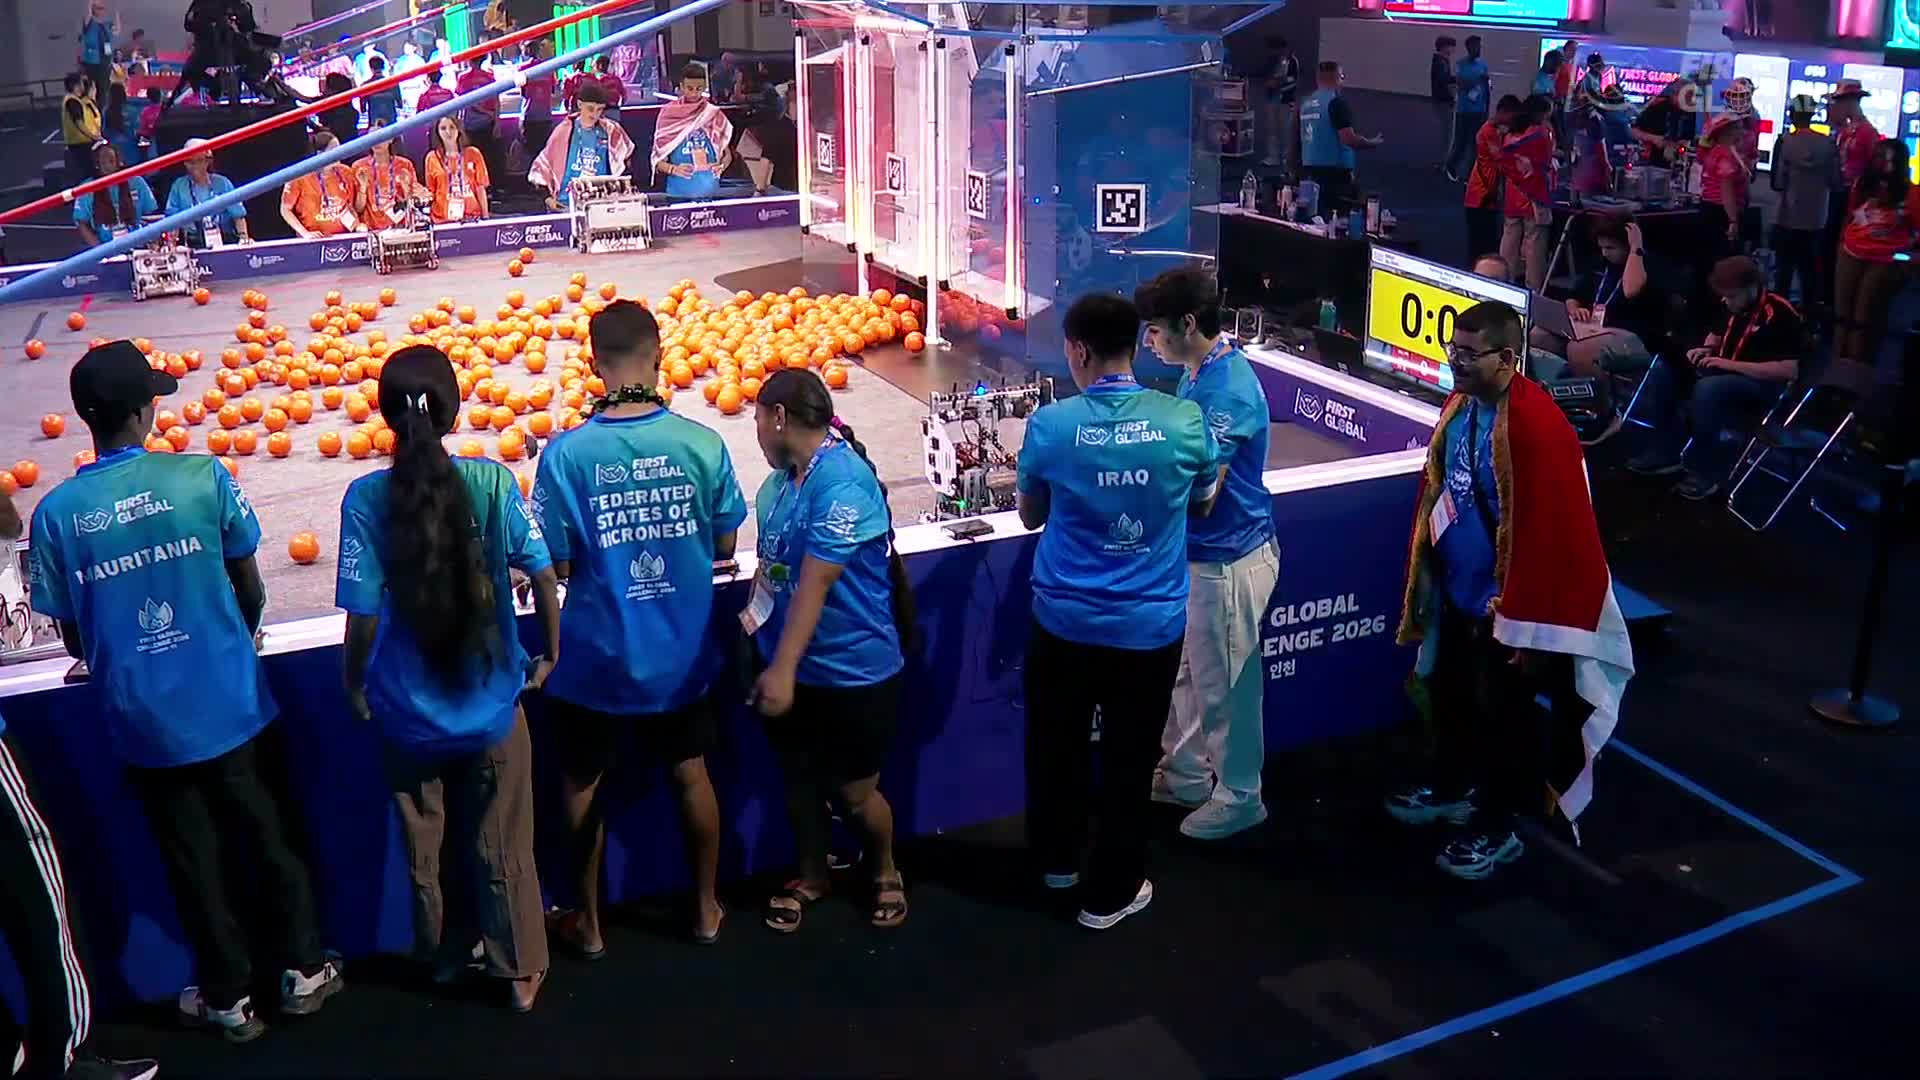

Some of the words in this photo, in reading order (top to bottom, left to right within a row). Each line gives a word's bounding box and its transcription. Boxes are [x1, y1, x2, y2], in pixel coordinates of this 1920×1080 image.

[1647, 70, 1680, 84] GLOBA
[690, 209, 716, 220] FIRST
[525, 224, 553, 235] FIRST
[525, 231, 564, 244] GLOBAL
[1325, 399, 1356, 421] FIRST
[1114, 420, 1150, 433] FIRST
[1114, 430, 1167, 445] GLOBAL
[1324, 413, 1368, 443] GLOBAL
[632, 455, 669, 470] FIRST
[632, 465, 685, 481] GLOBAL
[1097, 469, 1150, 487] IRAQ
[114, 491, 153, 513] FIRST
[588, 484, 696, 513] FEDERATED
[116, 498, 175, 525] GLOBAL
[596, 506, 663, 531] STATES
[668, 502, 692, 519] OF
[74, 536, 203, 585] MAURITANIA
[1270, 593, 1359, 627] GLOBAL
[1262, 627, 1324, 658] ENGE
[1331, 614, 1386, 643] 2026
[1269, 658, 1296, 680] 인천
